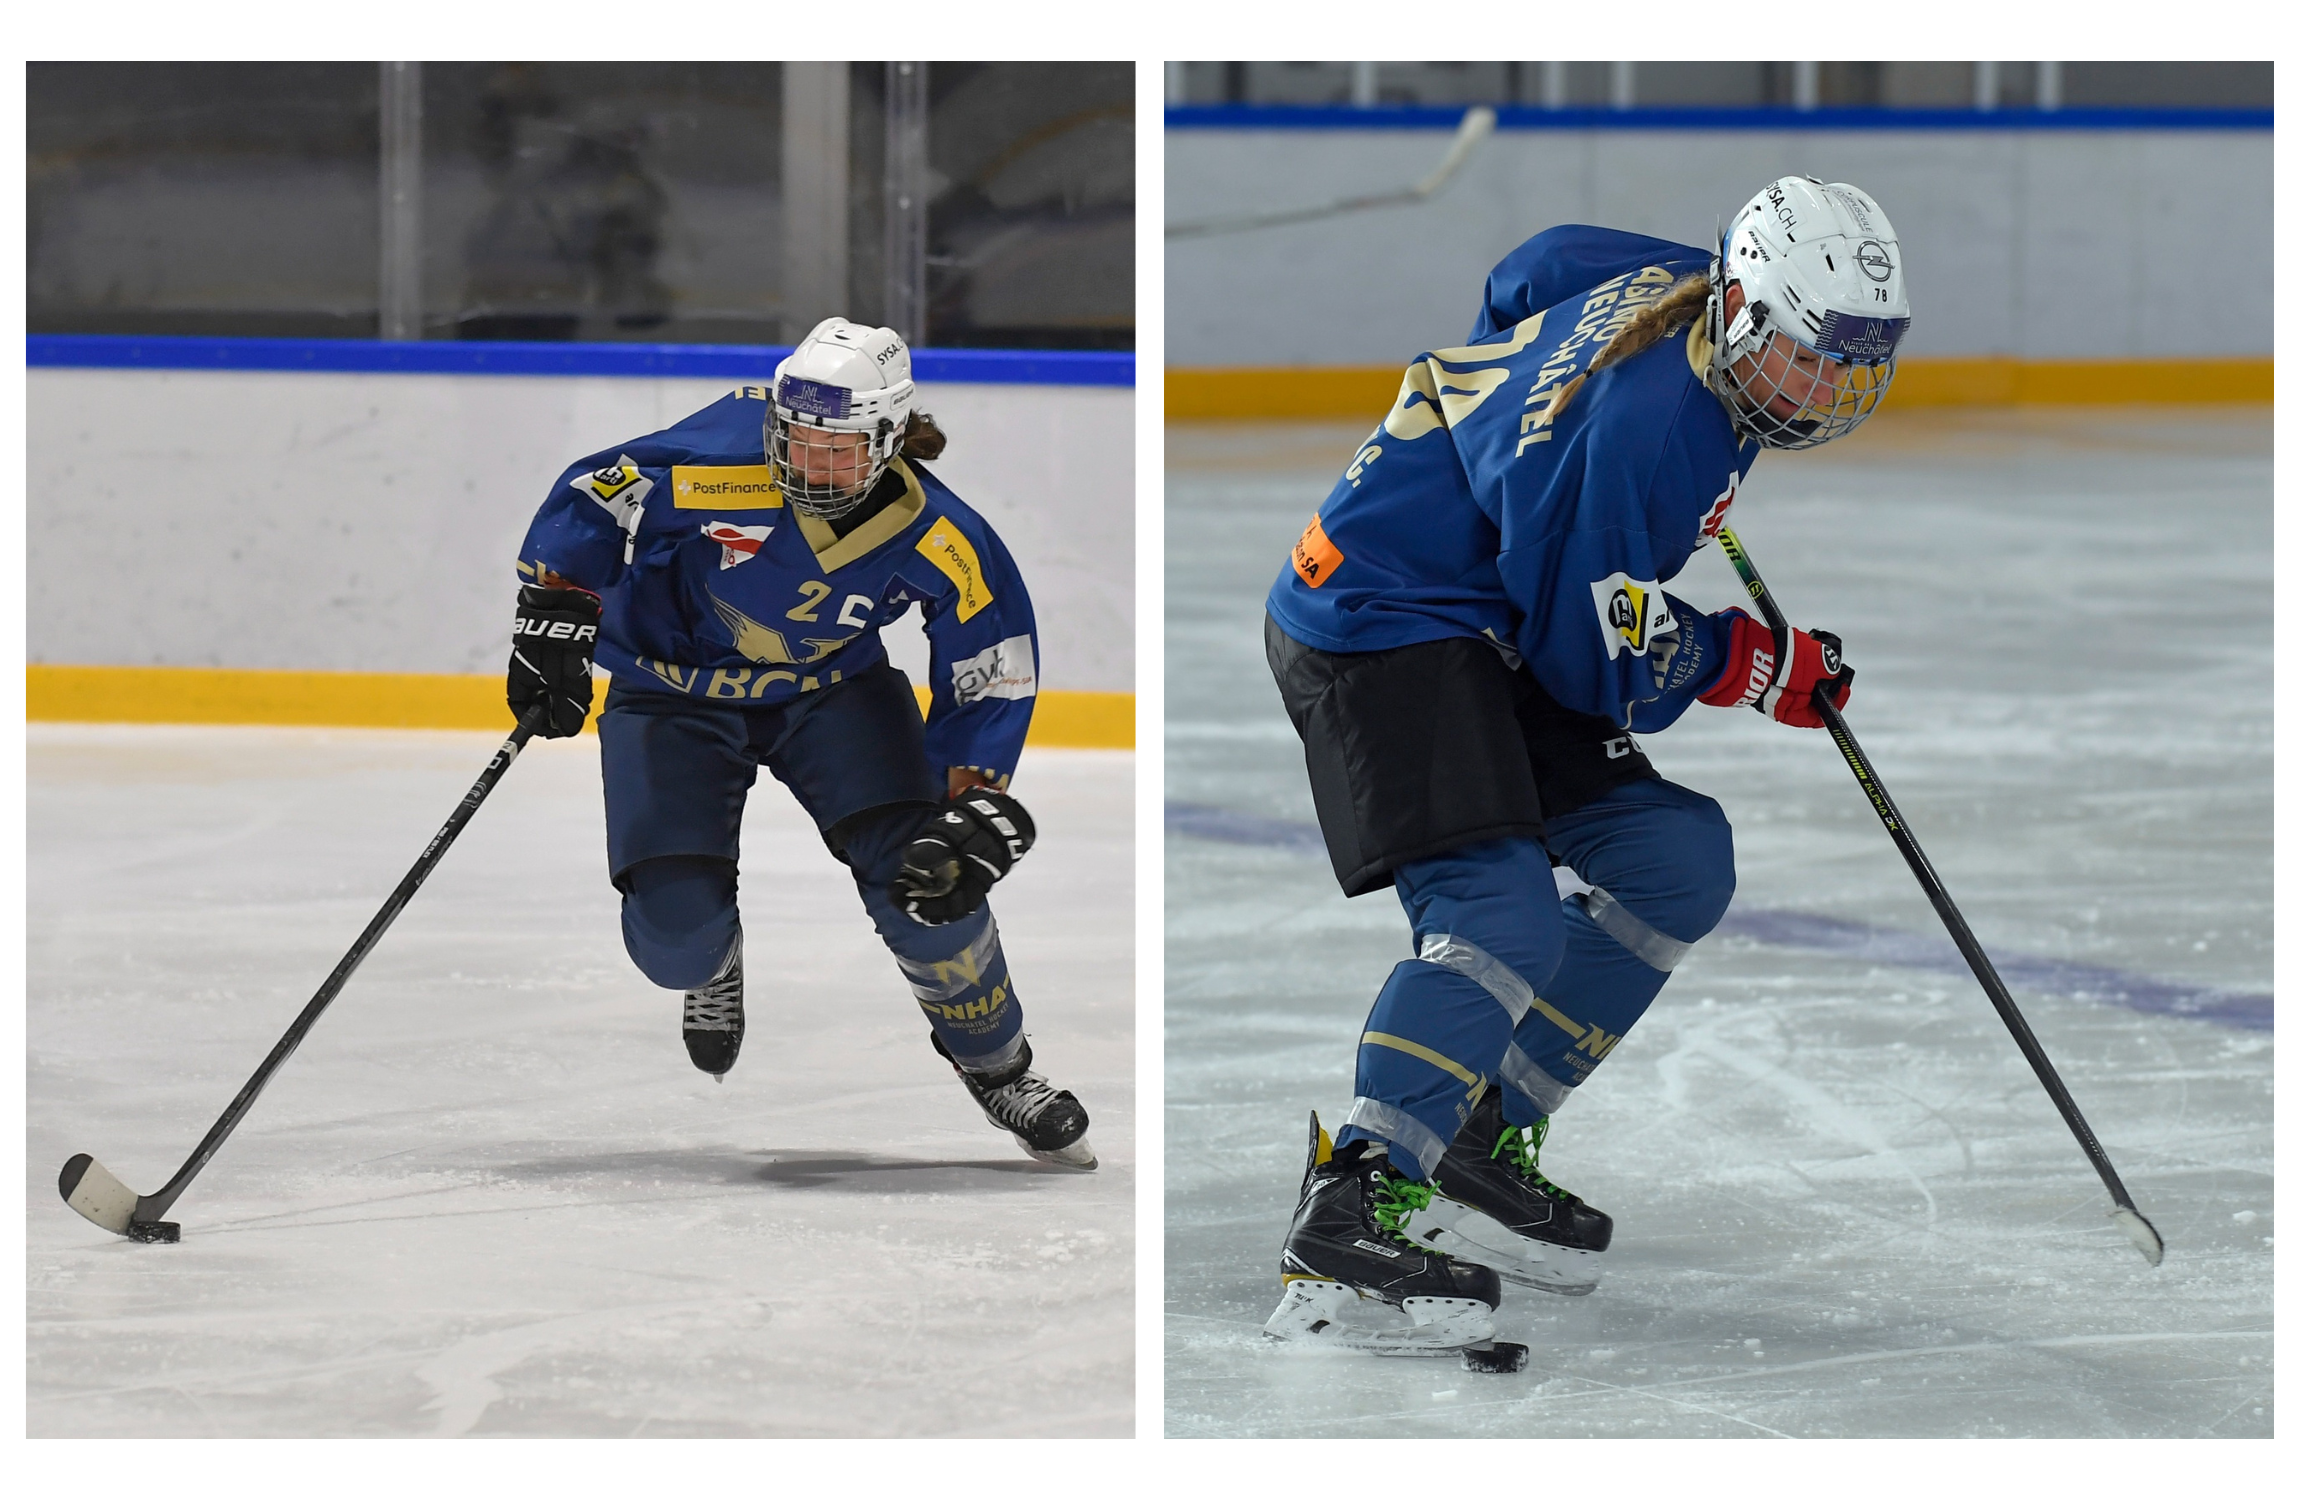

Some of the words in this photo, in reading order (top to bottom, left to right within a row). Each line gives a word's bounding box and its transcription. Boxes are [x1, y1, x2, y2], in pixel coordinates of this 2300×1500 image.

[1593, 260, 1681, 342] ASINO
[1874, 287, 1888, 303] 78
[1838, 339, 1893, 356] Neuchâtel
[785, 396, 832, 416] Neuchâtel
[692, 481, 777, 495] PostFinance
[1301, 556, 1320, 580] SA
[785, 580, 833, 623] 2
[1680, 612, 1694, 656] HOCKEY
[1864, 783, 1888, 816] ALPHA
[935, 985, 1007, 1020] NHA
[947, 1020, 988, 1030] NEUCHATEL
[988, 1002, 1010, 1023] HOCKEY
[968, 1021, 1001, 1035] ACADEMY
[1357, 1240, 1396, 1257] BAUER
